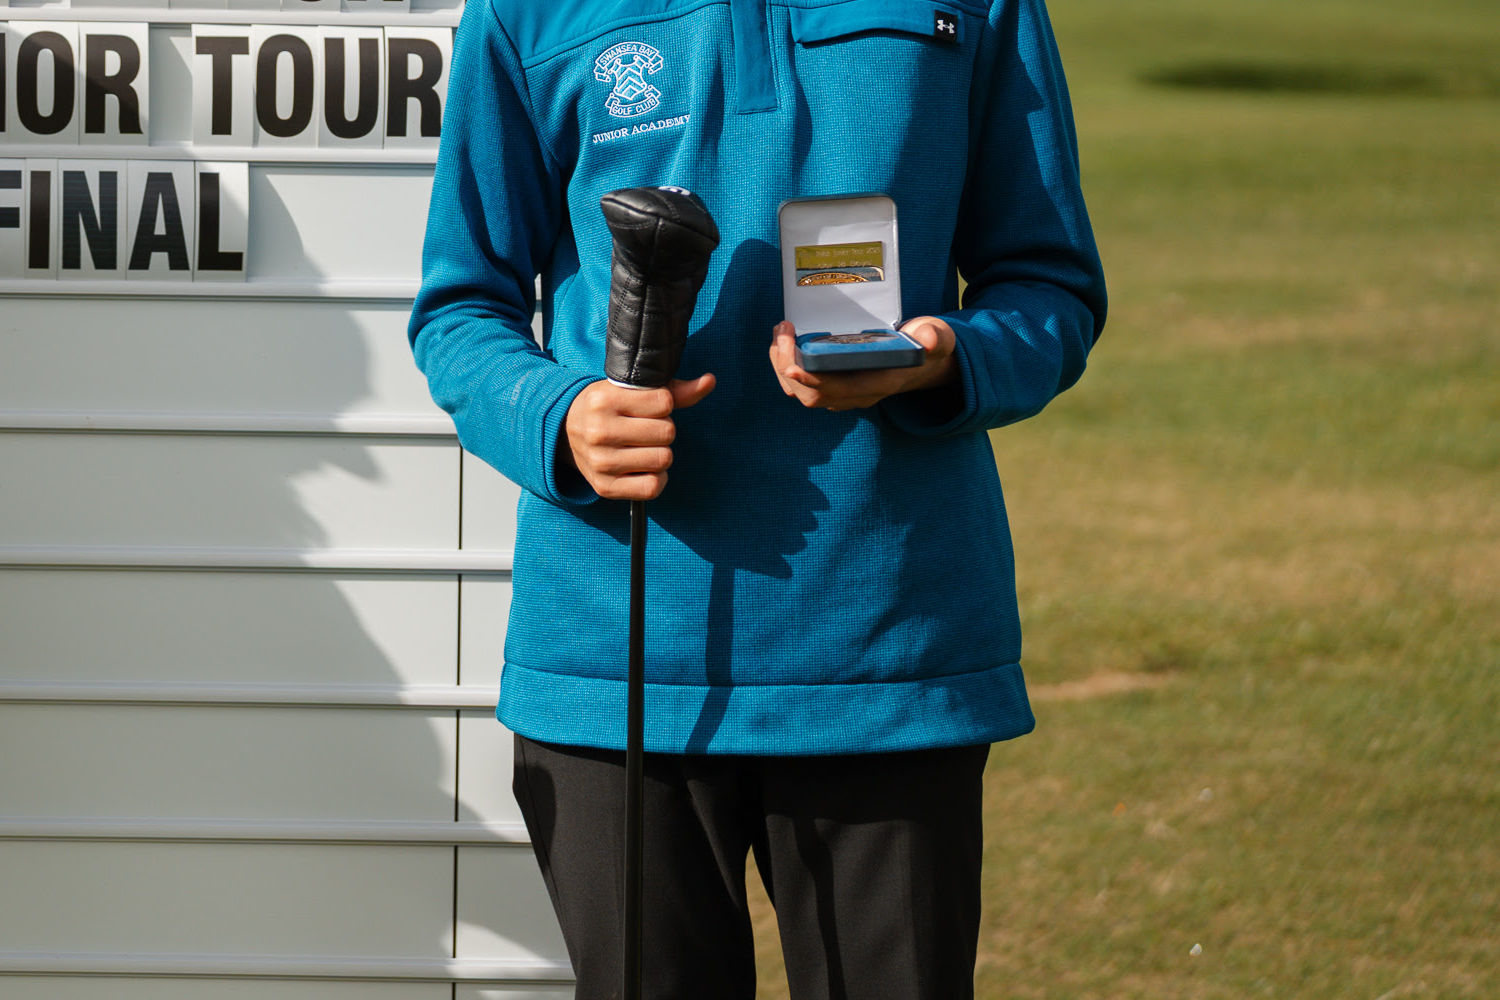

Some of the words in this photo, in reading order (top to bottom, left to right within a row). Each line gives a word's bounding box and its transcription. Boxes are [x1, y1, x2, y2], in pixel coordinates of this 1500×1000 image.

[600, 44, 638, 66] SWANSEA
[638, 45, 656, 57] BAY
[195, 35, 443, 140] TOUR
[612, 106, 632, 115] GOLF
[635, 98, 656, 113] CLUB
[592, 127, 630, 144] JUNIOR
[631, 114, 690, 135] ACADEMY
